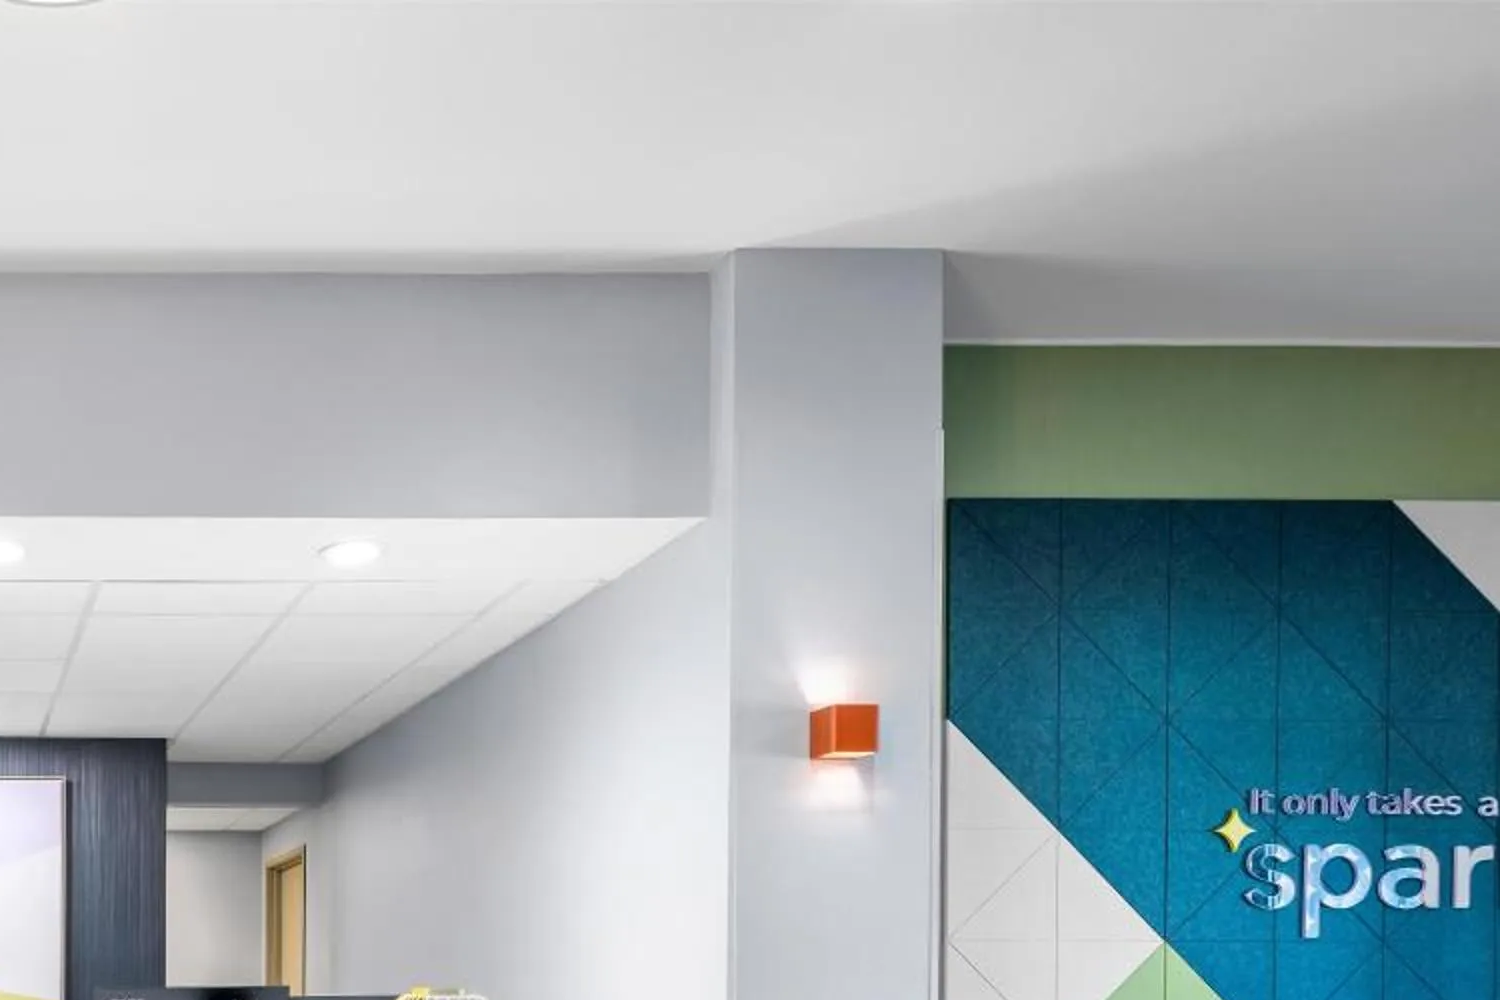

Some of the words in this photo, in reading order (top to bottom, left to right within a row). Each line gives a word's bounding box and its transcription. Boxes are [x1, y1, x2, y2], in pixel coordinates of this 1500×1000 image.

[1249, 787, 1275, 816] It
[1281, 787, 1360, 822] only
[1365, 787, 1463, 817] takes
[1477, 795, 1499, 817] a
